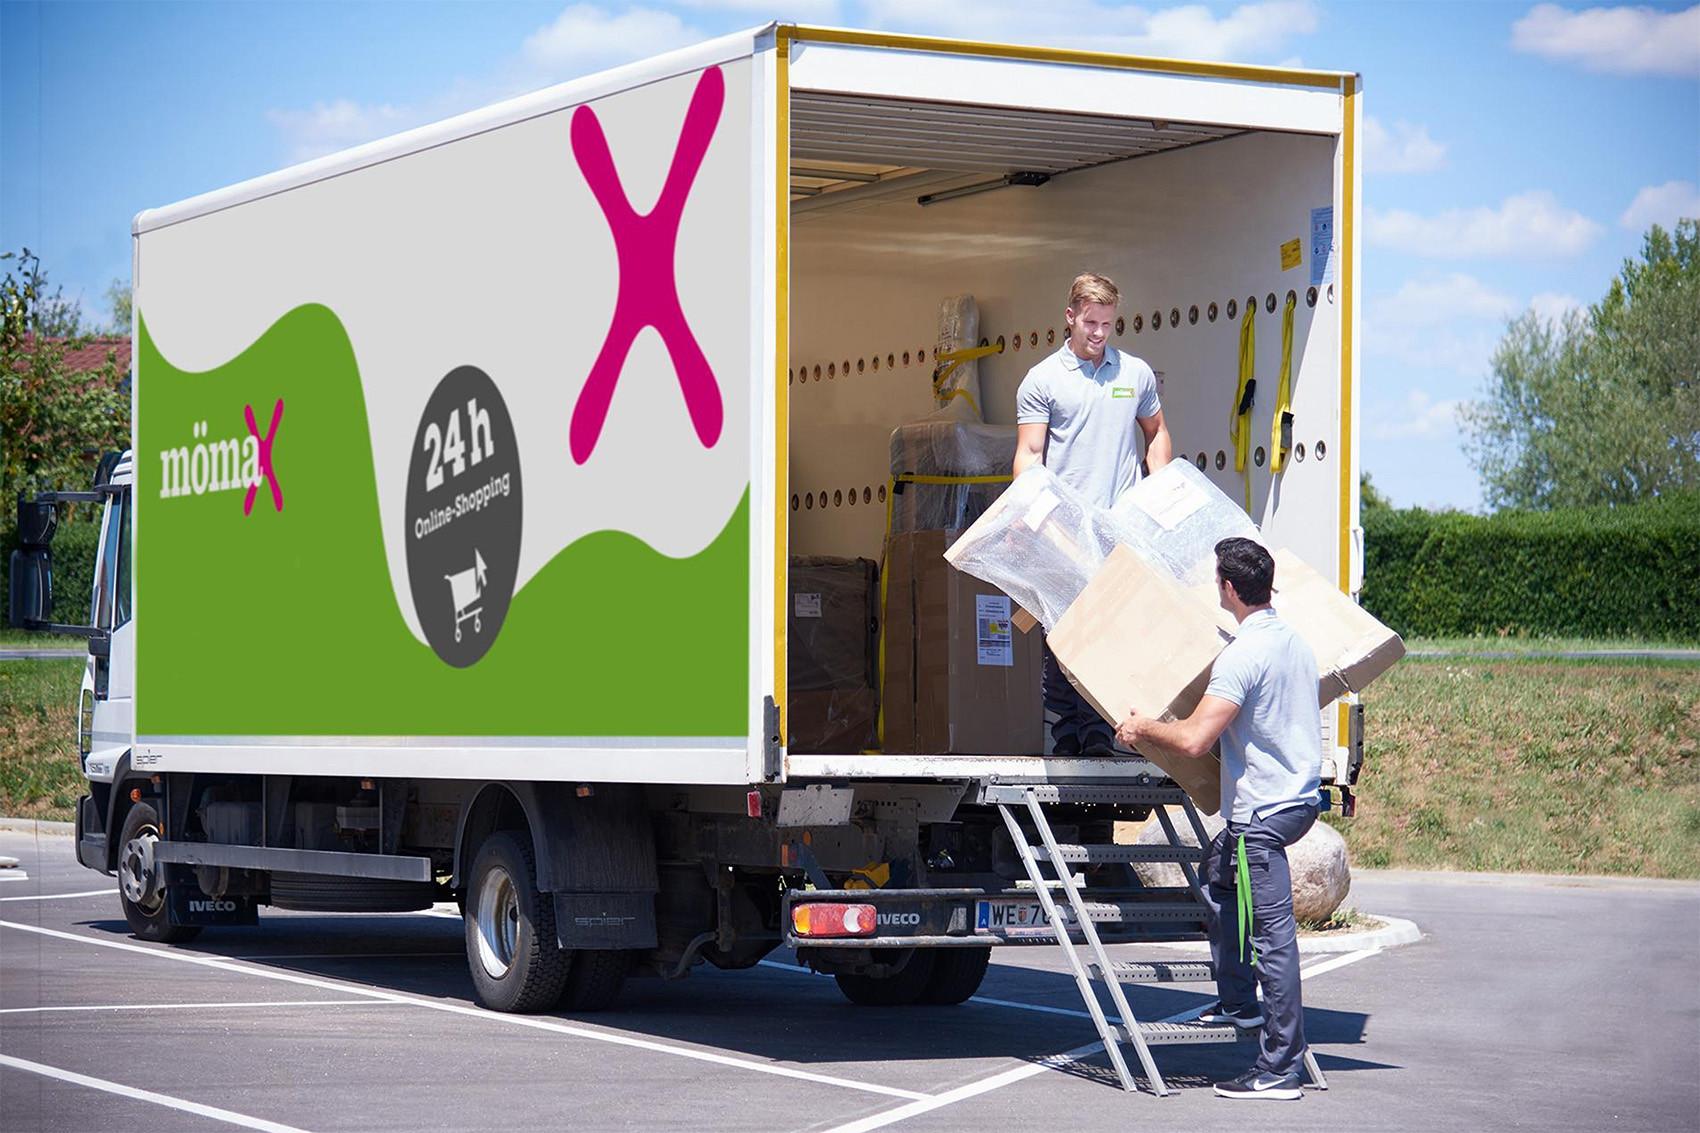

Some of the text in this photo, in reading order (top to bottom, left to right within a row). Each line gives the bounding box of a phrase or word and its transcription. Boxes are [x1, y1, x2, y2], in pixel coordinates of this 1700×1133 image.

[415, 472, 510, 539] Online-Shopping
[189, 900, 237, 912] IVECO
[877, 912, 920, 925] IVECO
[992, 905, 1016, 925] WE
